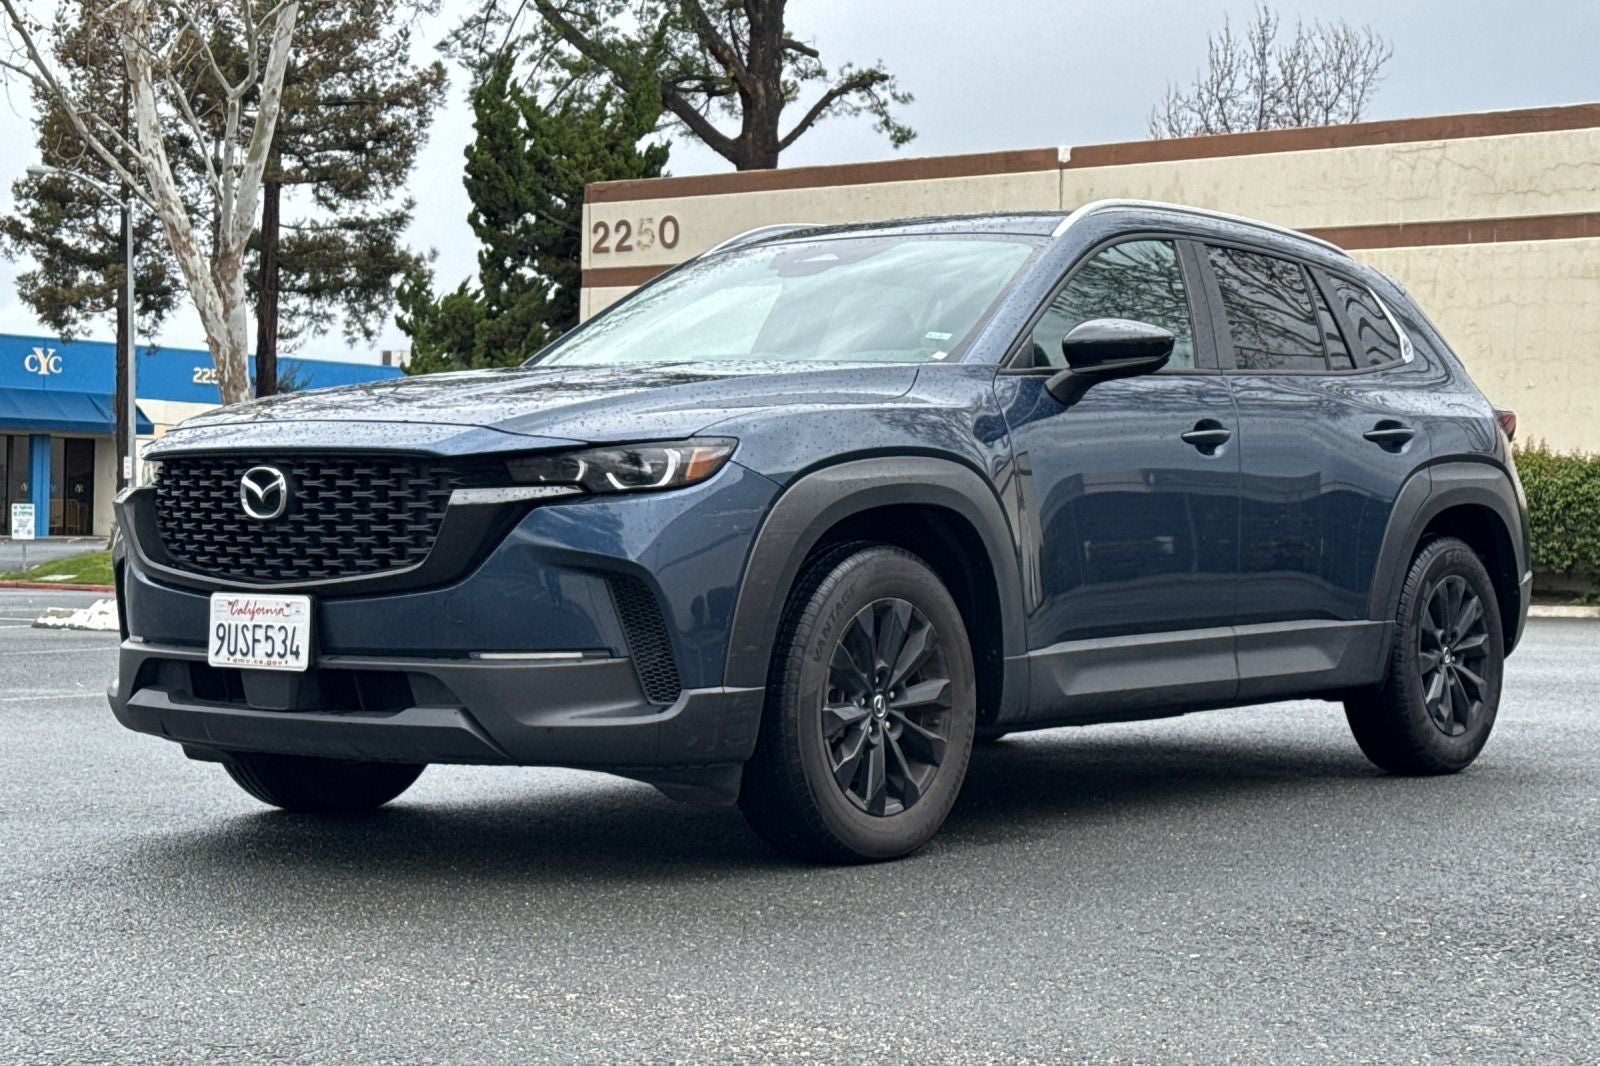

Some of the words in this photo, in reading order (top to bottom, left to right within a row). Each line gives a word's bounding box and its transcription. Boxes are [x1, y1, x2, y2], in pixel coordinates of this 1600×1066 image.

[592, 214, 680, 254] 2250
[24, 347, 63, 375] CYC
[230, 598, 290, 621] California
[214, 622, 300, 660] 9USF534
[232, 657, 283, 666] dmv.ca.gov
